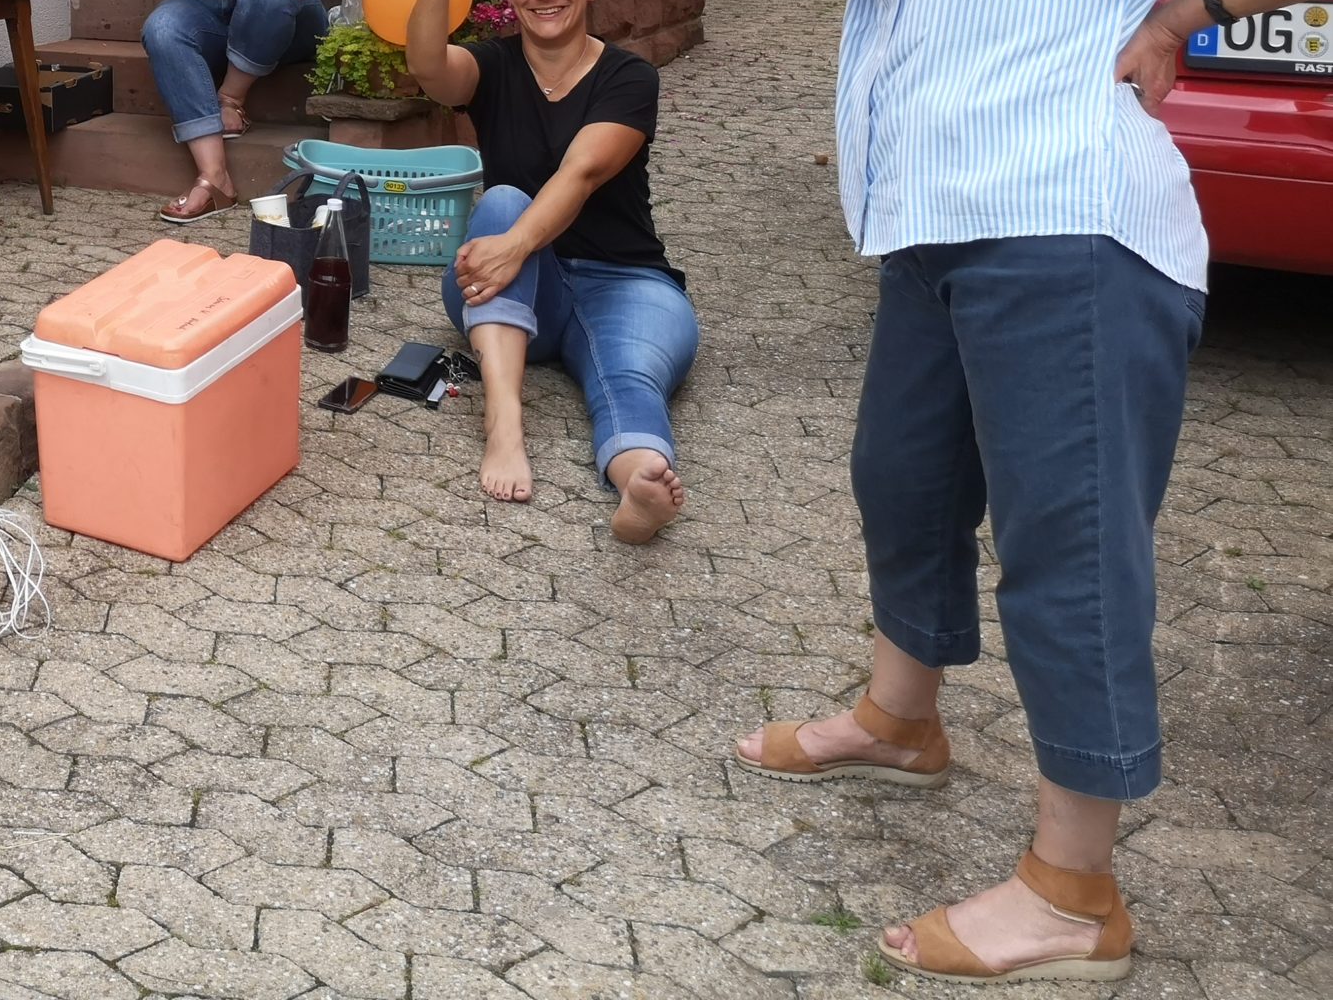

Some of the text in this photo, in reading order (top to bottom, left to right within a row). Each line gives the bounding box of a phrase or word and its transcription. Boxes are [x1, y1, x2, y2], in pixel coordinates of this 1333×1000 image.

[1224, 9, 1293, 54] OG
[1197, 33, 1209, 47] D
[1294, 63, 1333, 73] RAST
